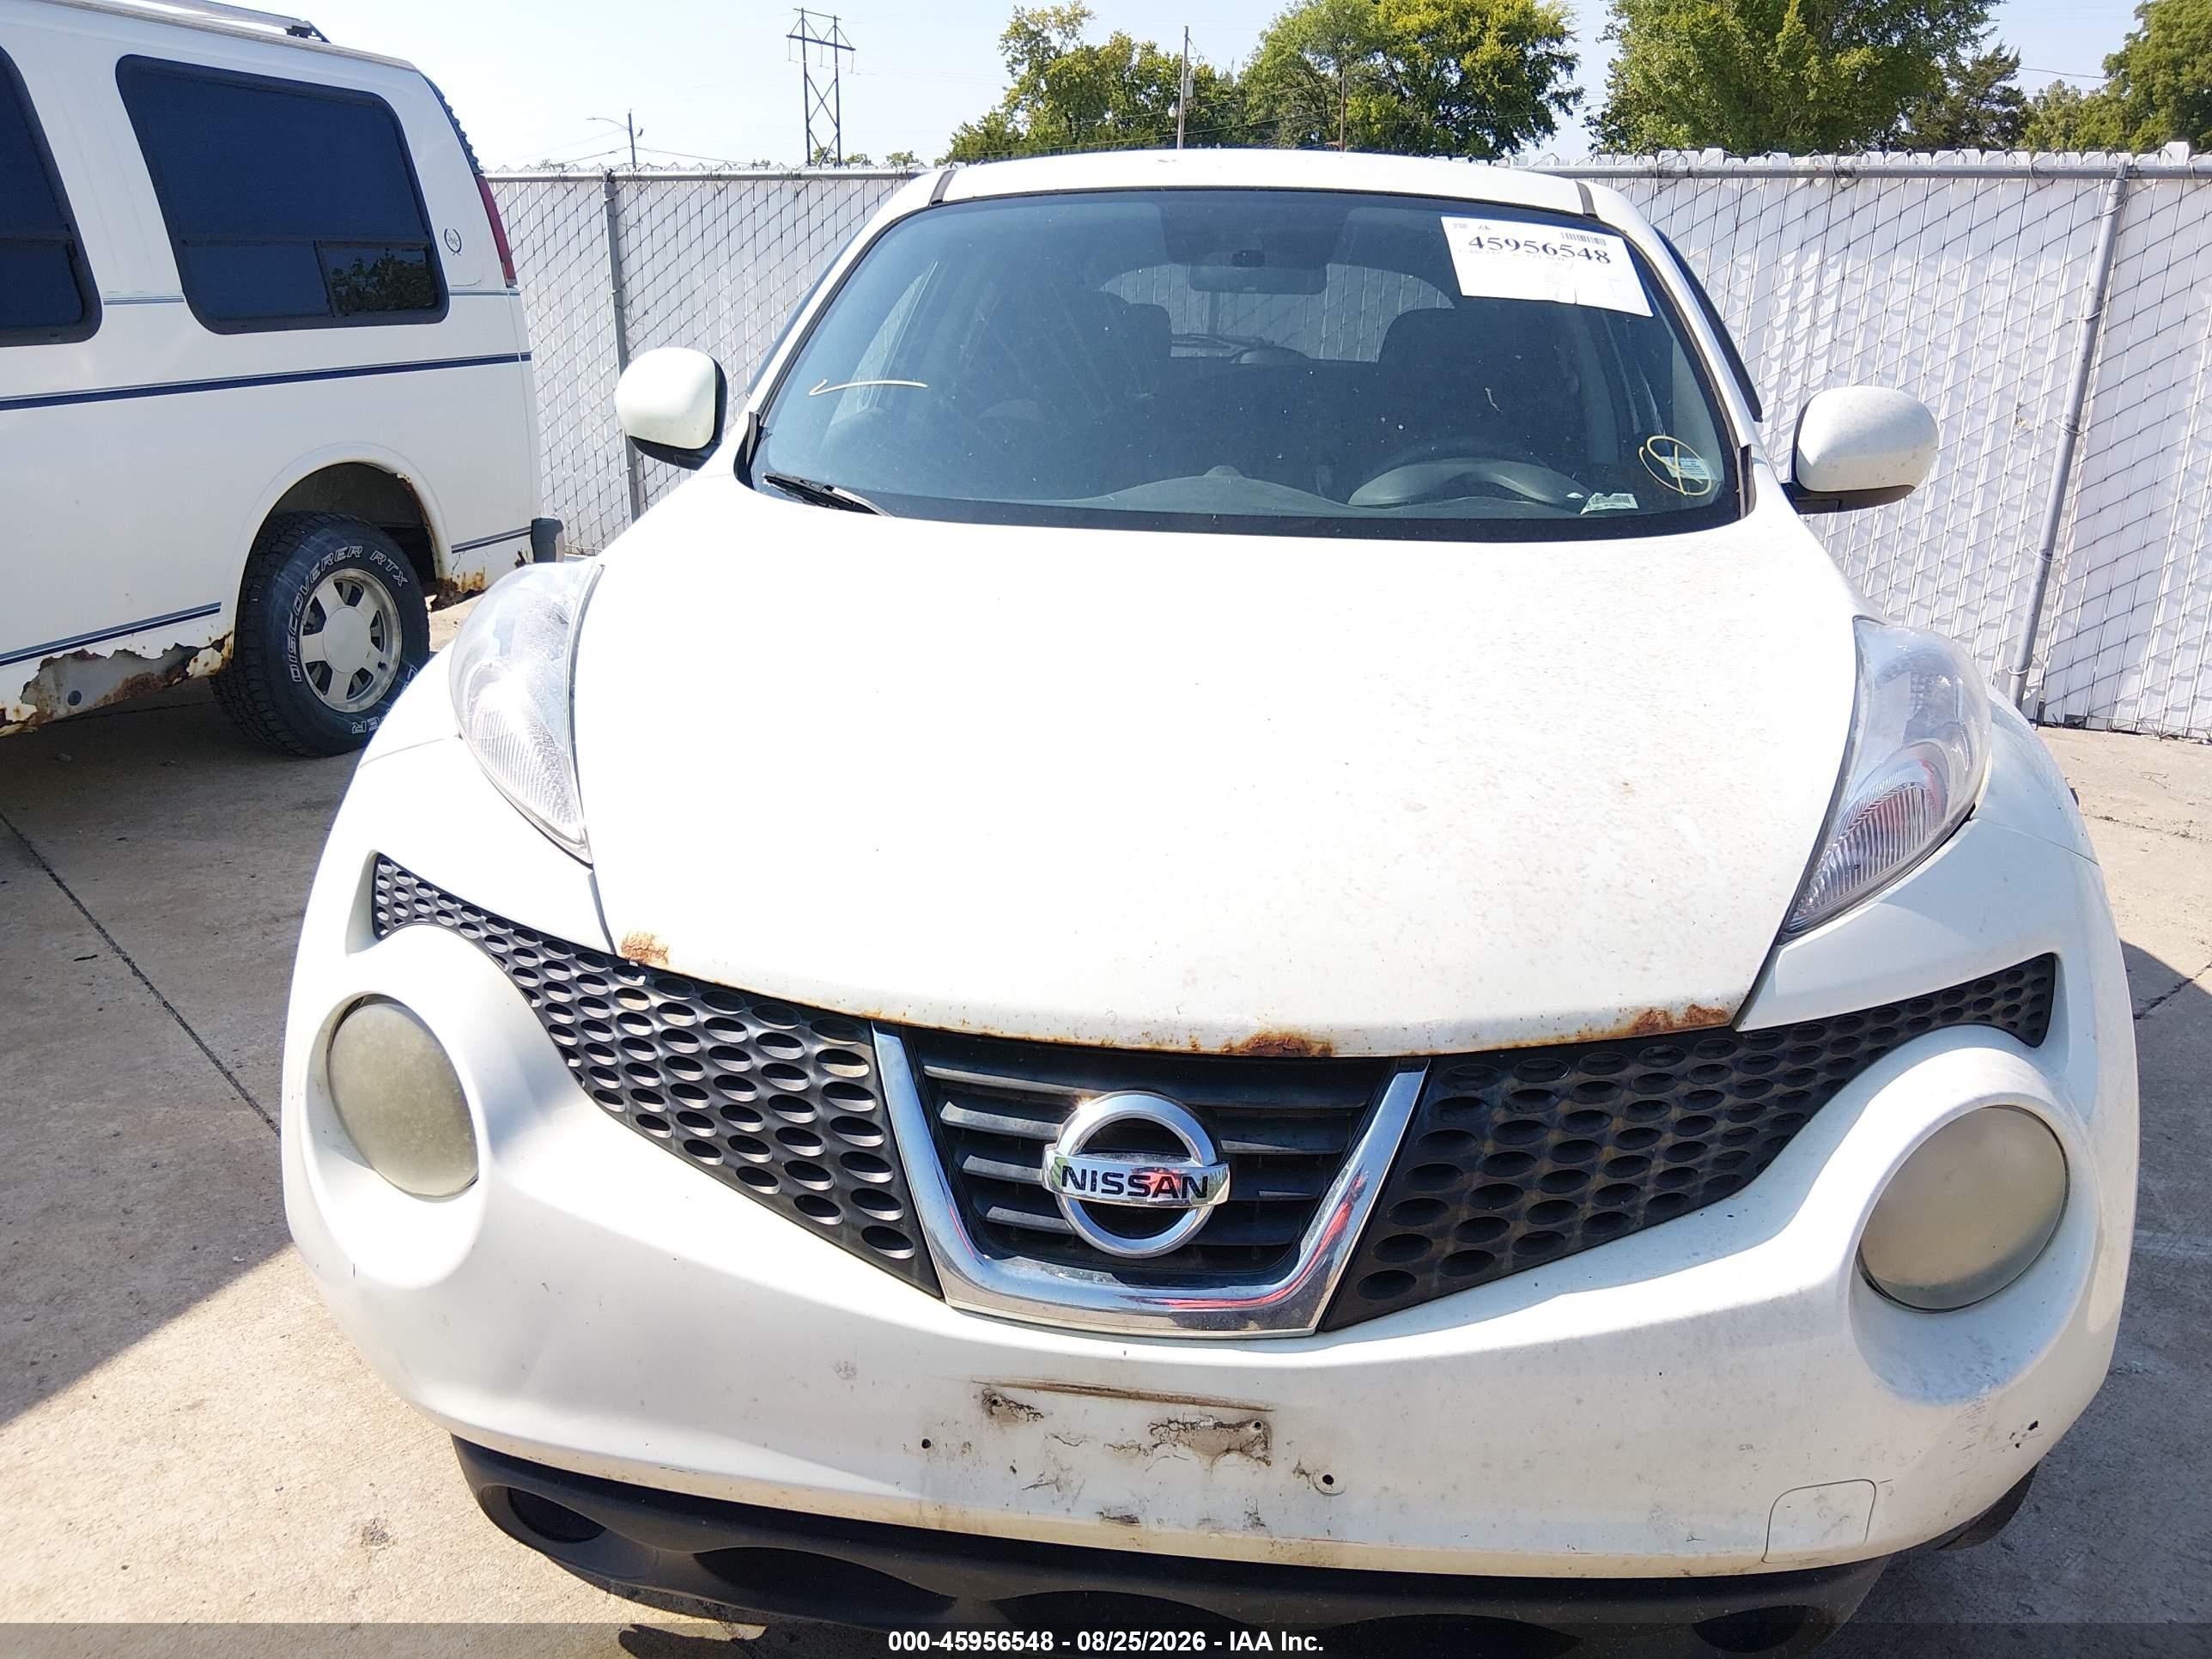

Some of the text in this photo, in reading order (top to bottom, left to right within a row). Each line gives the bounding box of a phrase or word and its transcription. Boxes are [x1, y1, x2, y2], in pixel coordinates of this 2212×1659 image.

[1468, 235, 1612, 264] 45956548
[289, 546, 409, 682] DISCOVERER RTX
[1060, 1164, 1209, 1200] NISSAN
